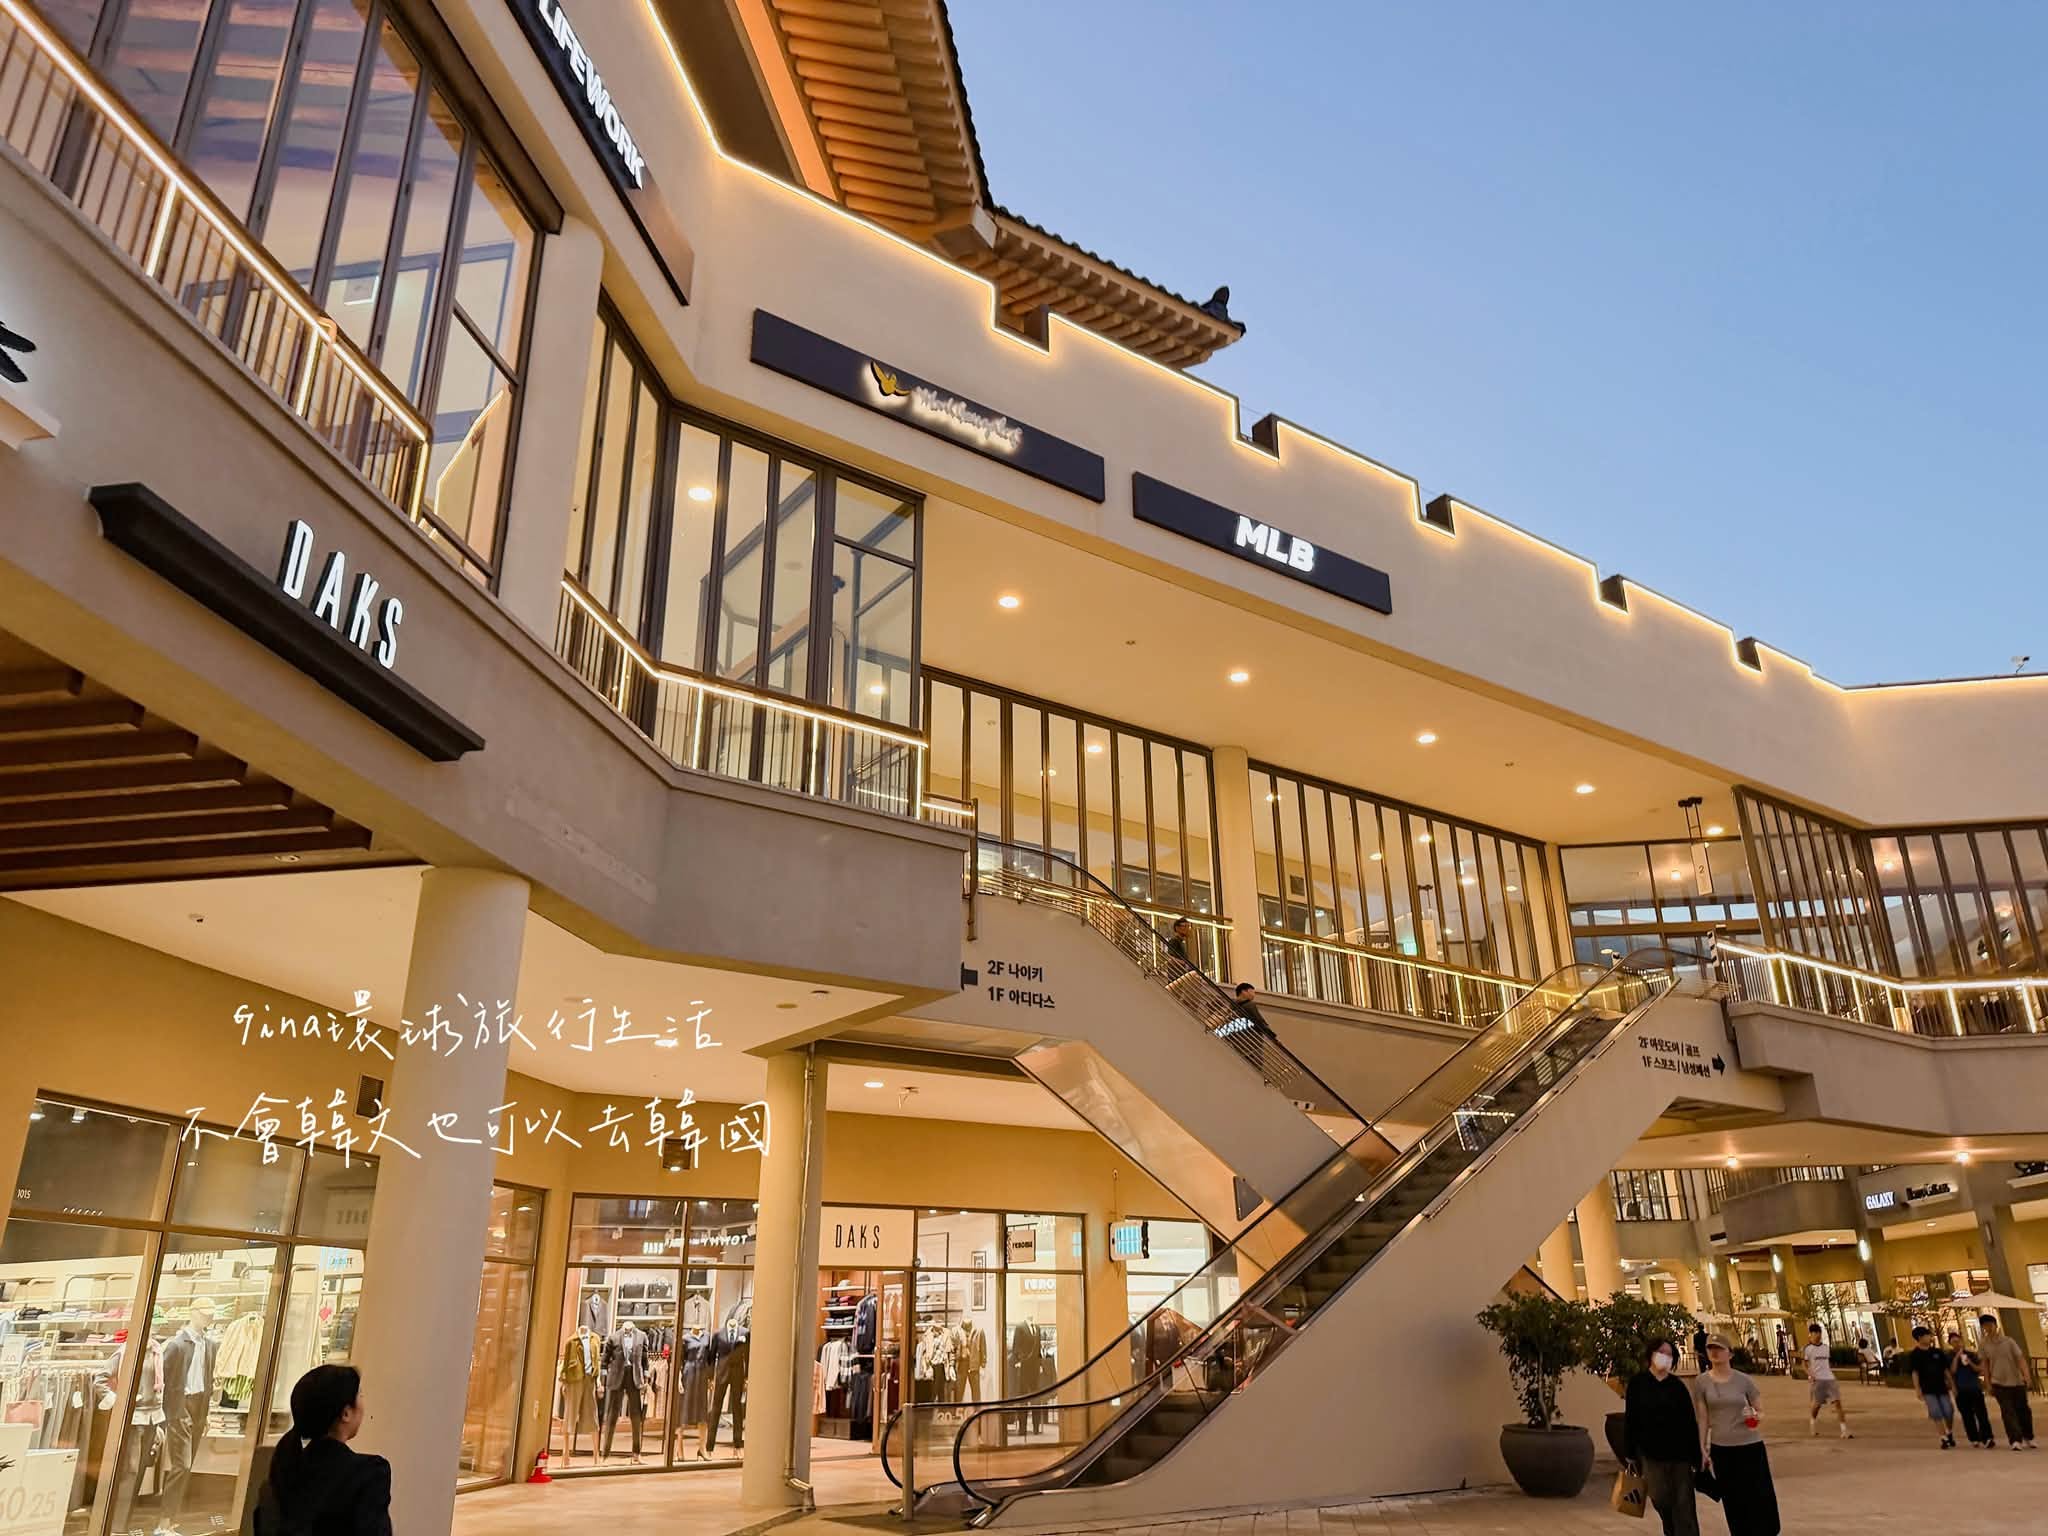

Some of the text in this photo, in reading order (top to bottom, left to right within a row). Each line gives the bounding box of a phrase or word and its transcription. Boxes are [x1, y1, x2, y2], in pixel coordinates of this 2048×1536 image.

[1236, 515, 1314, 572] MLB
[281, 519, 403, 669] DAKS
[987, 960, 1043, 983] 2F 나이키
[987, 986, 1055, 1008] 1F 아디다스
[1638, 1036, 1648, 1049] 2F
[1866, 1191, 1895, 1210] GALAXY
[835, 1224, 880, 1249] DAKS
